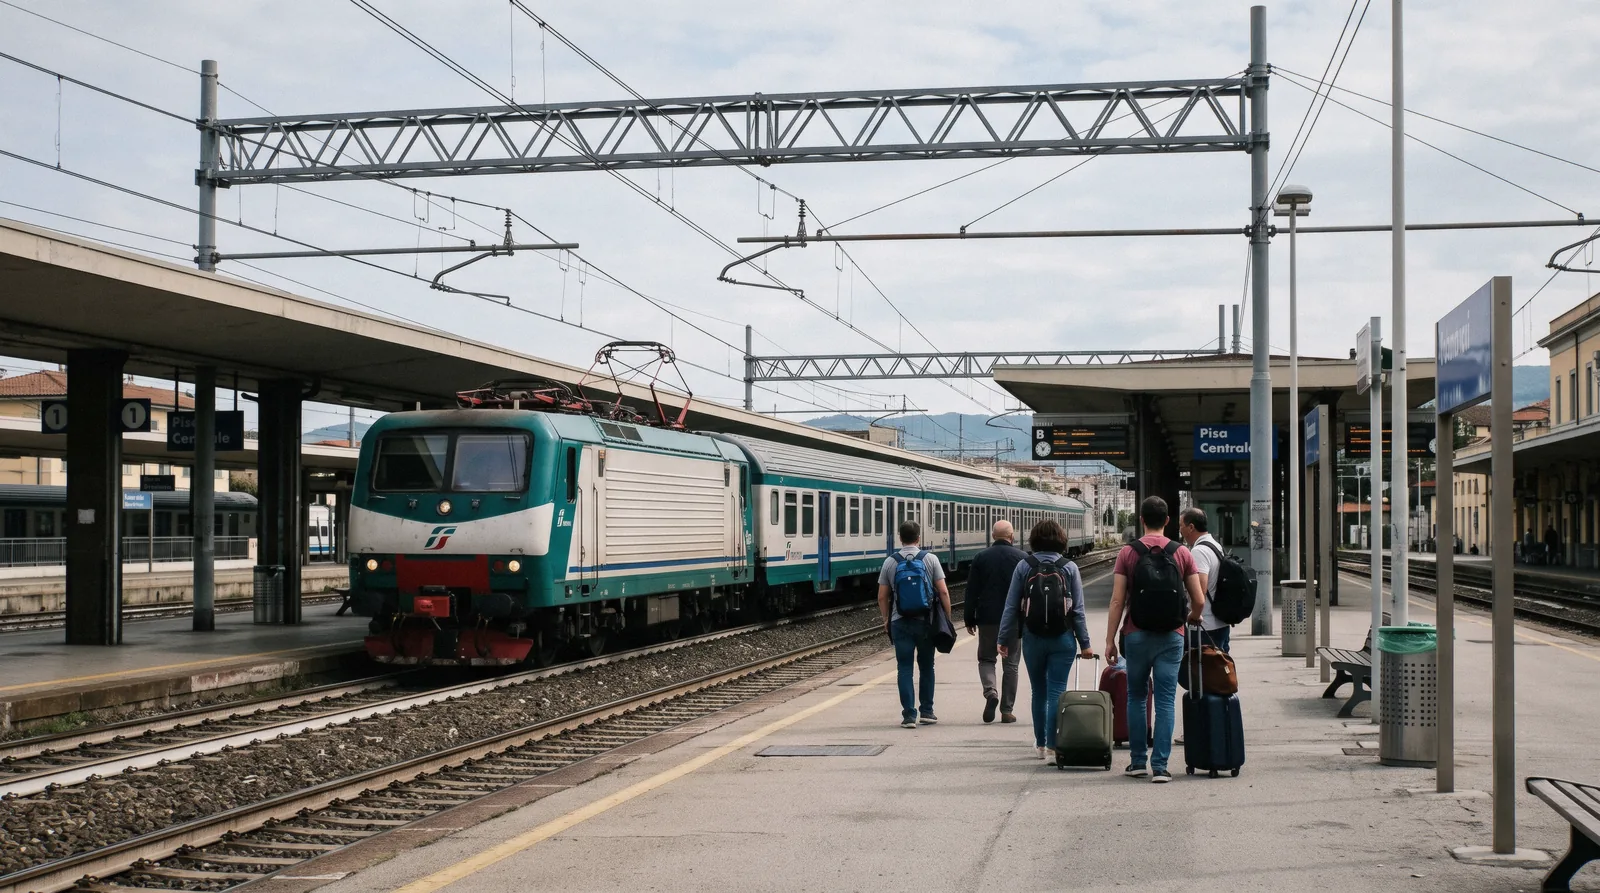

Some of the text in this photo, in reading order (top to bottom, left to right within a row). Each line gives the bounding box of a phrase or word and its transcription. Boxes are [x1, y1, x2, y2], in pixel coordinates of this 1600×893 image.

[53, 409, 60, 425] 1
[129, 407, 137, 424] 1
[1036, 429, 1045, 440] B
[1200, 427, 1228, 439] Pisa
